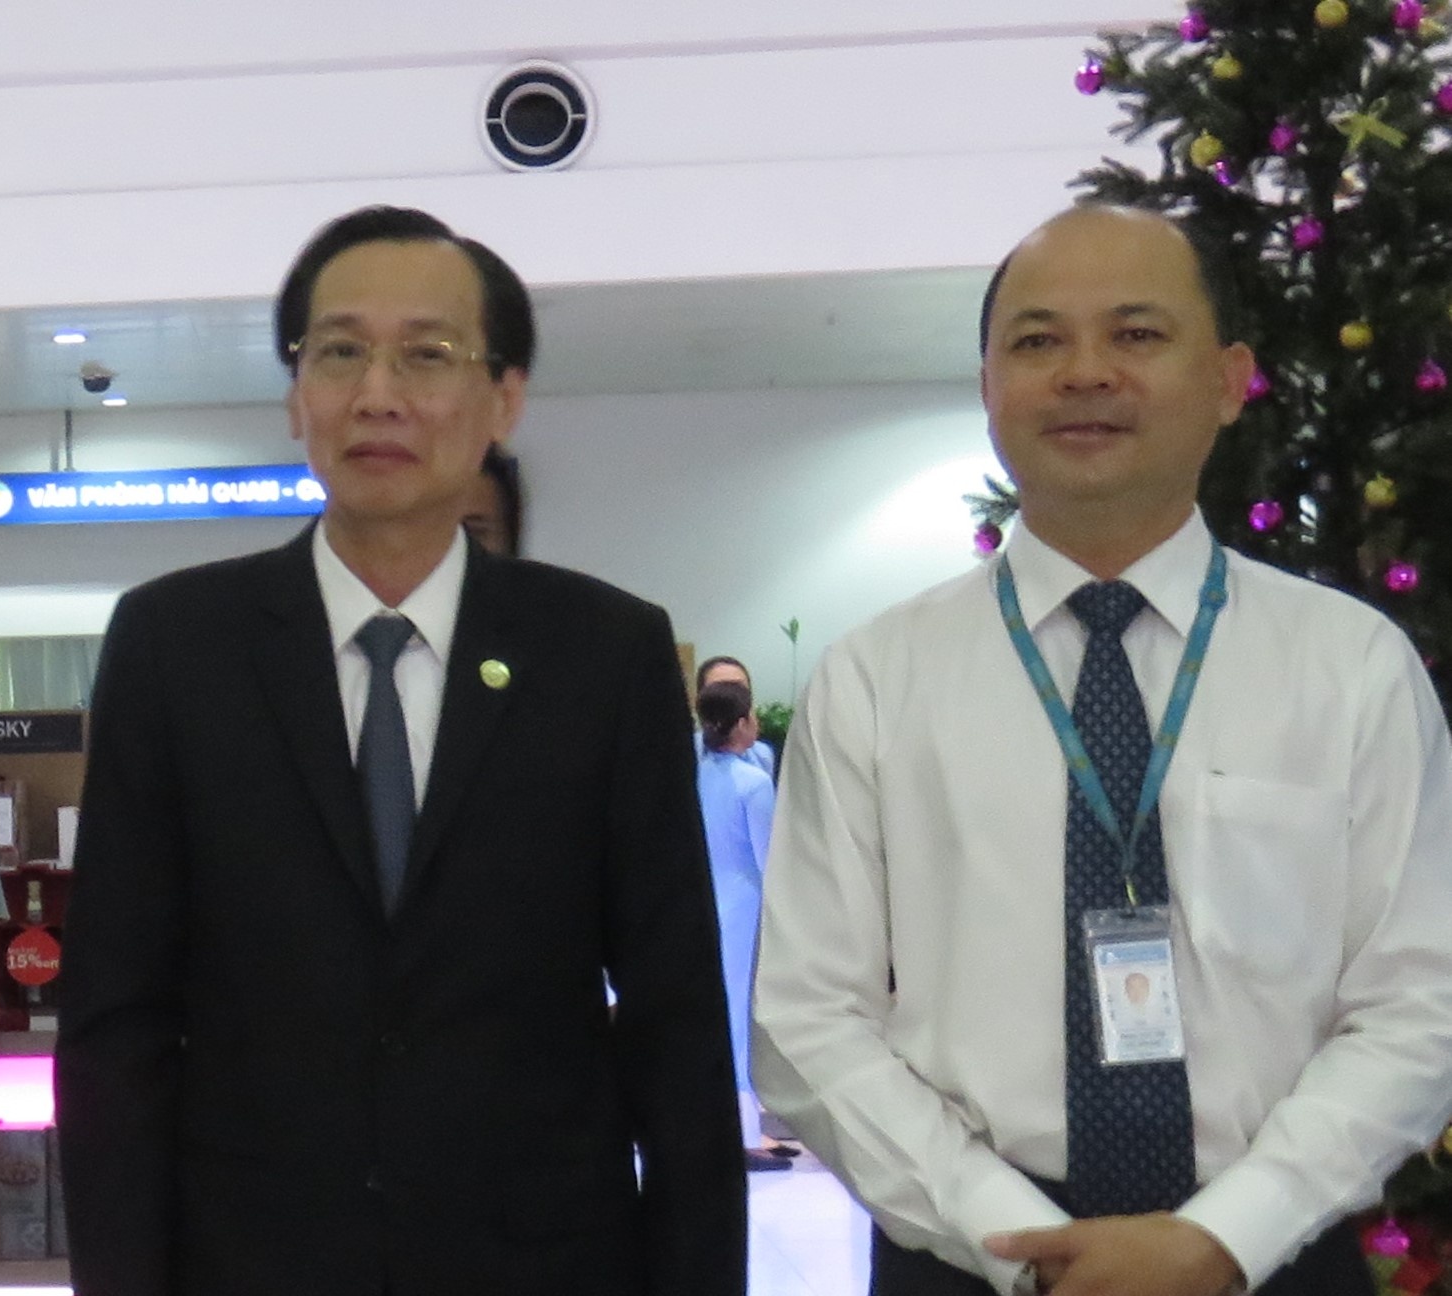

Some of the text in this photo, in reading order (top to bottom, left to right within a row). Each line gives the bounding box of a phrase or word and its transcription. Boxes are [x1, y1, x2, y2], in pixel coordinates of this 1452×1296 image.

[28, 483, 77, 507] VĂN
[80, 480, 164, 505] PHÒNG
[211, 480, 279, 502] QUAN
